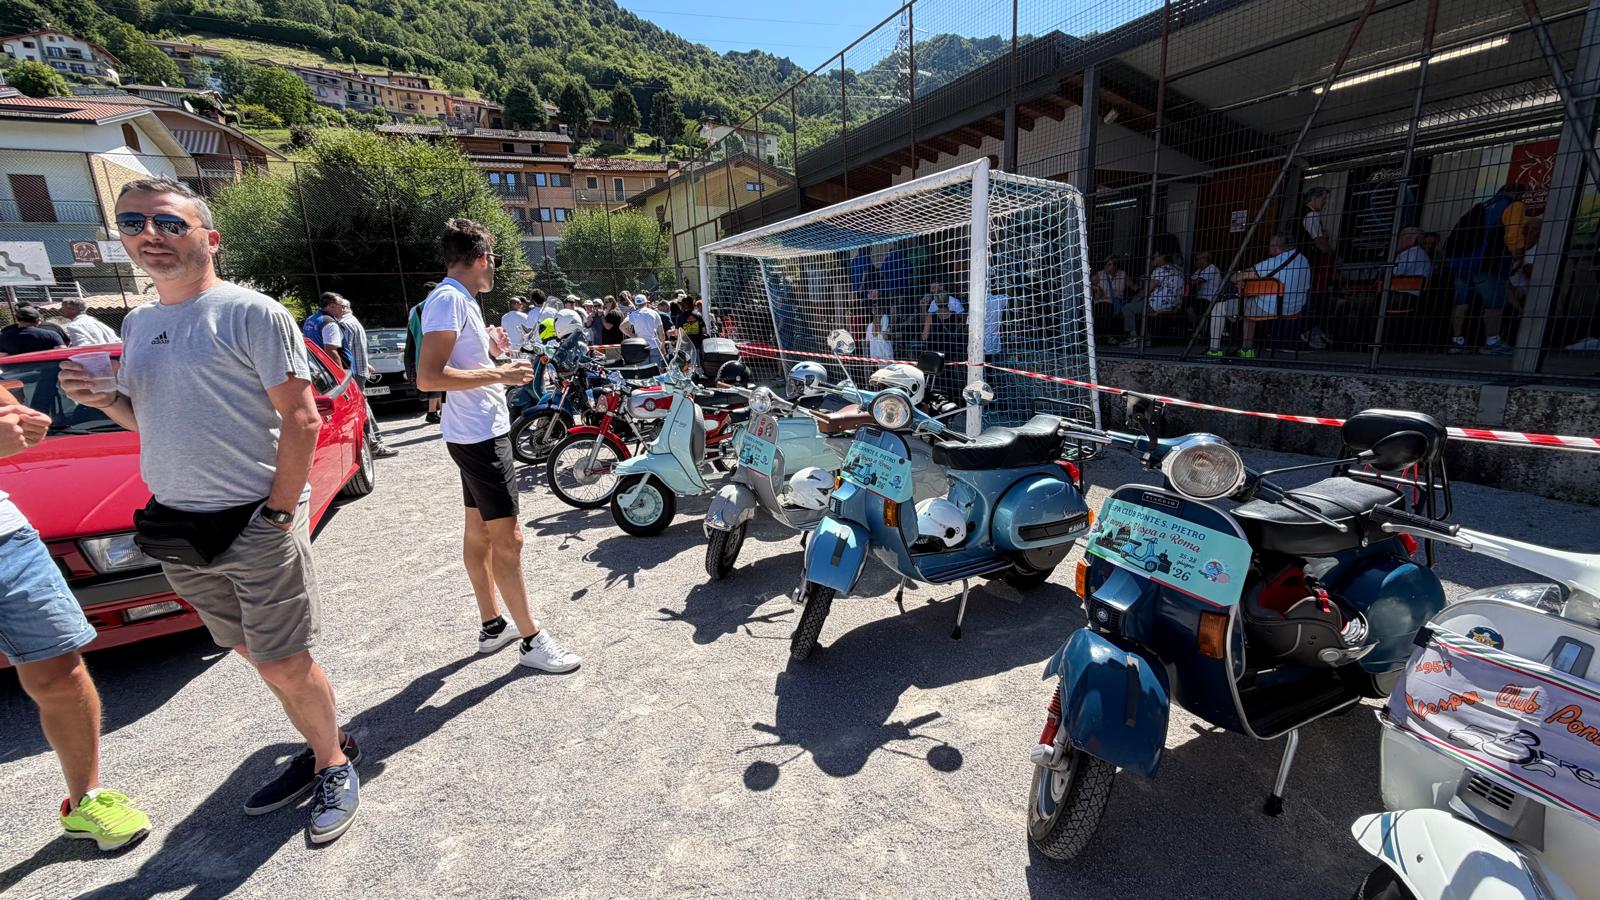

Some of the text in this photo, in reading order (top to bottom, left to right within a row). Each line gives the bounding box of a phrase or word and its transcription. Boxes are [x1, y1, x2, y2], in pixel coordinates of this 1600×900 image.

[1122, 507, 1137, 518] CLUB
[1136, 511, 1160, 526] PONTE
[1171, 523, 1206, 541] PIETRO
[1132, 522, 1158, 537] Vespa
[1170, 533, 1201, 553] Roma
[1172, 566, 1191, 582] '26
[1405, 683, 1600, 746] Vespa Club Pon
